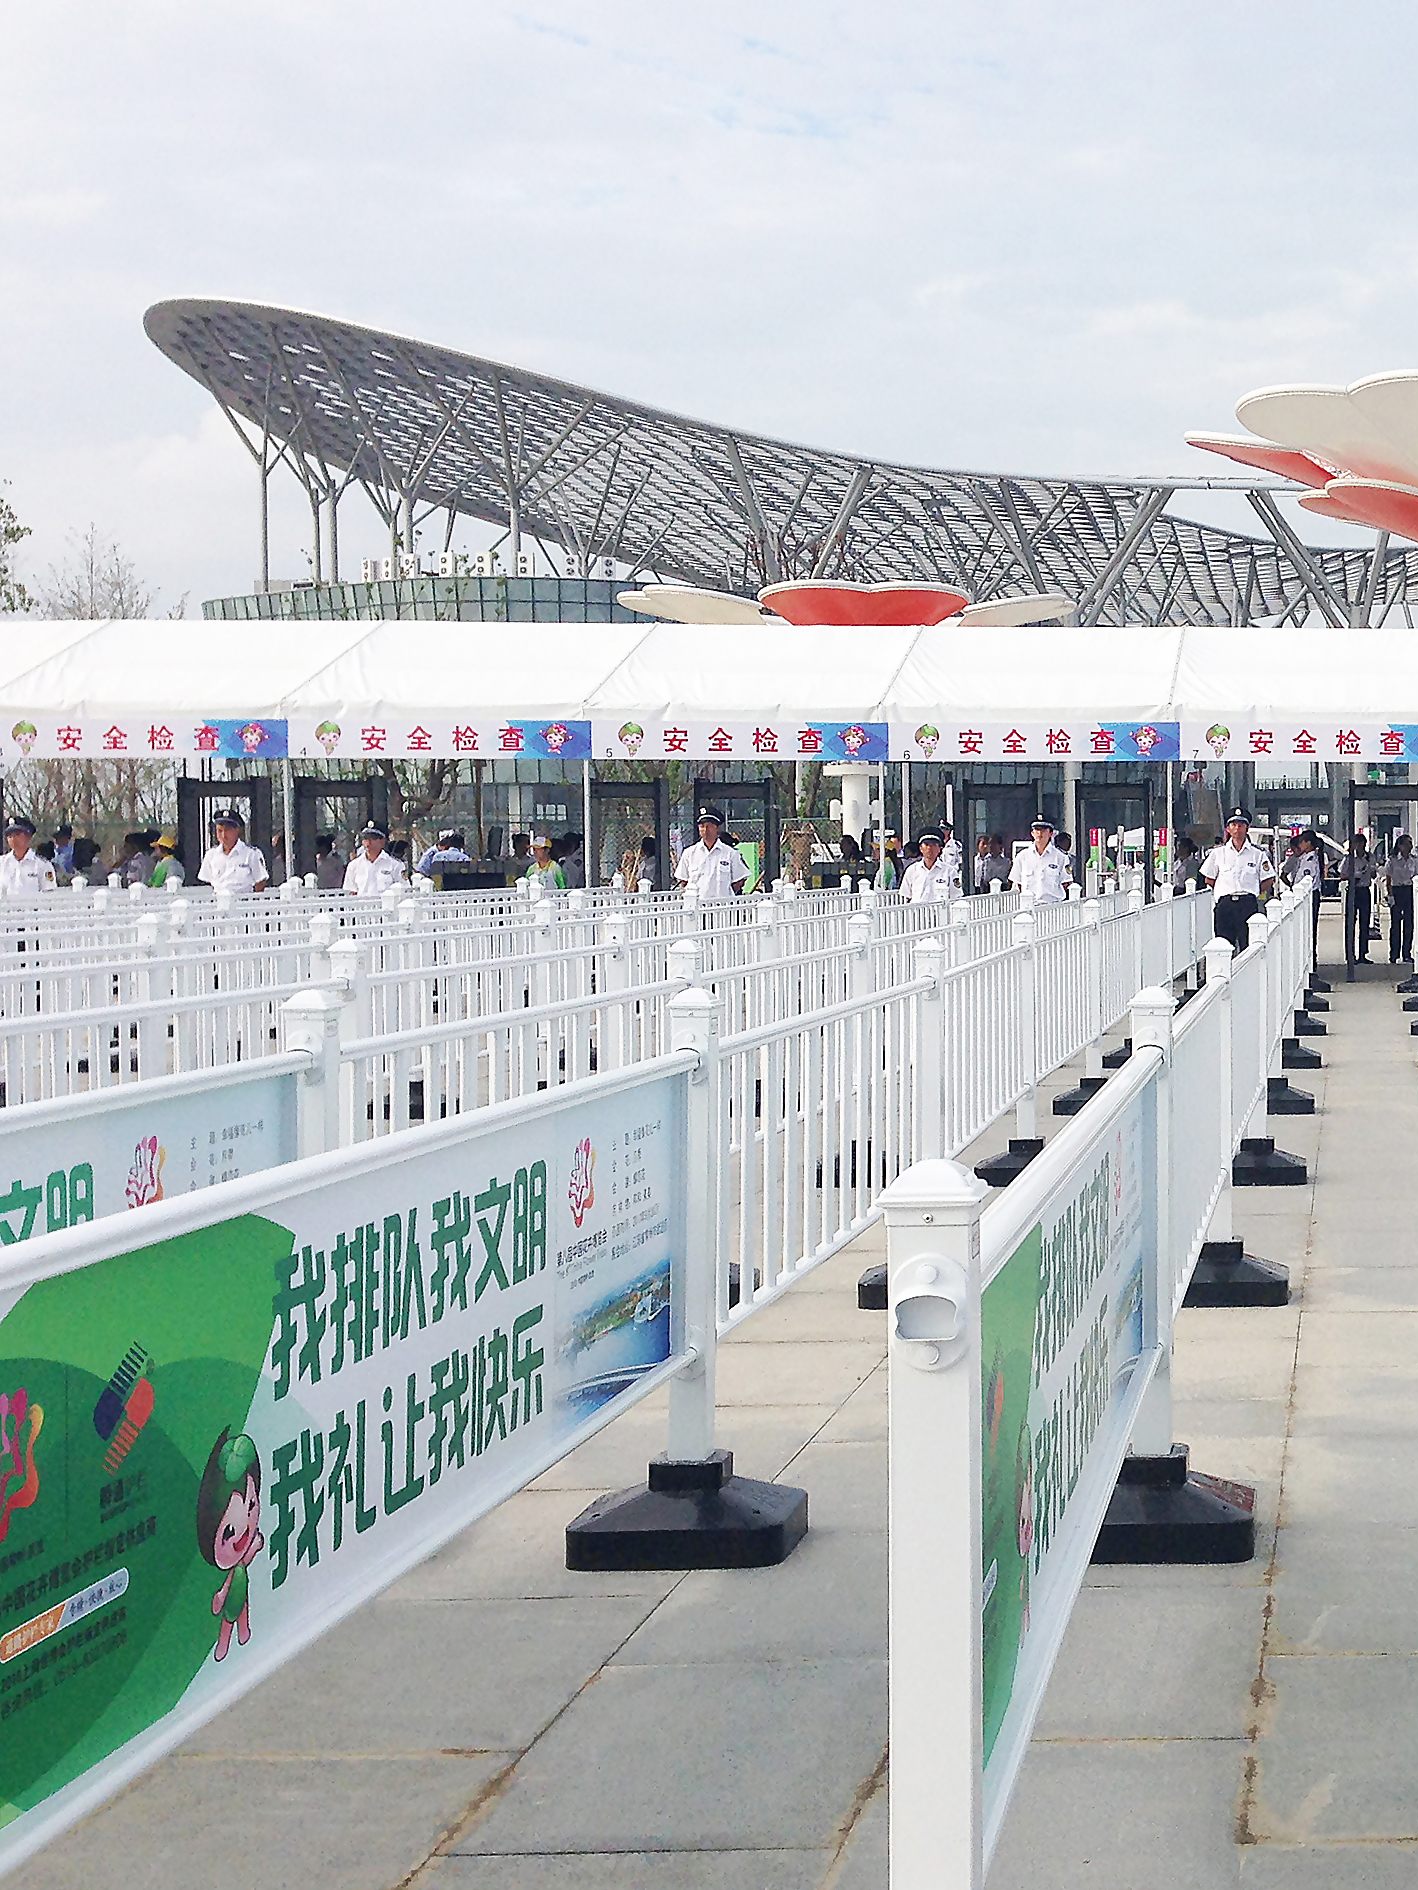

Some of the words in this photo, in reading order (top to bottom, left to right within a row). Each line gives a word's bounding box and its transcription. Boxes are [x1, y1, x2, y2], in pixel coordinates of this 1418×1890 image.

[57, 725, 220, 751] 安全检查
[361, 726, 524, 752] 安全检查
[663, 728, 823, 753] 安全检查
[958, 729, 1116, 754] 安全检查
[1249, 729, 1405, 755] 安全检查
[300, 747, 307, 757] 4
[606, 748, 613, 758] 5
[903, 750, 911, 760] 6
[1192, 750, 1199, 759] 7
[273, 1159, 547, 1402] 我排队我文明
[270, 1304, 544, 1590] 我礼让我快乐
